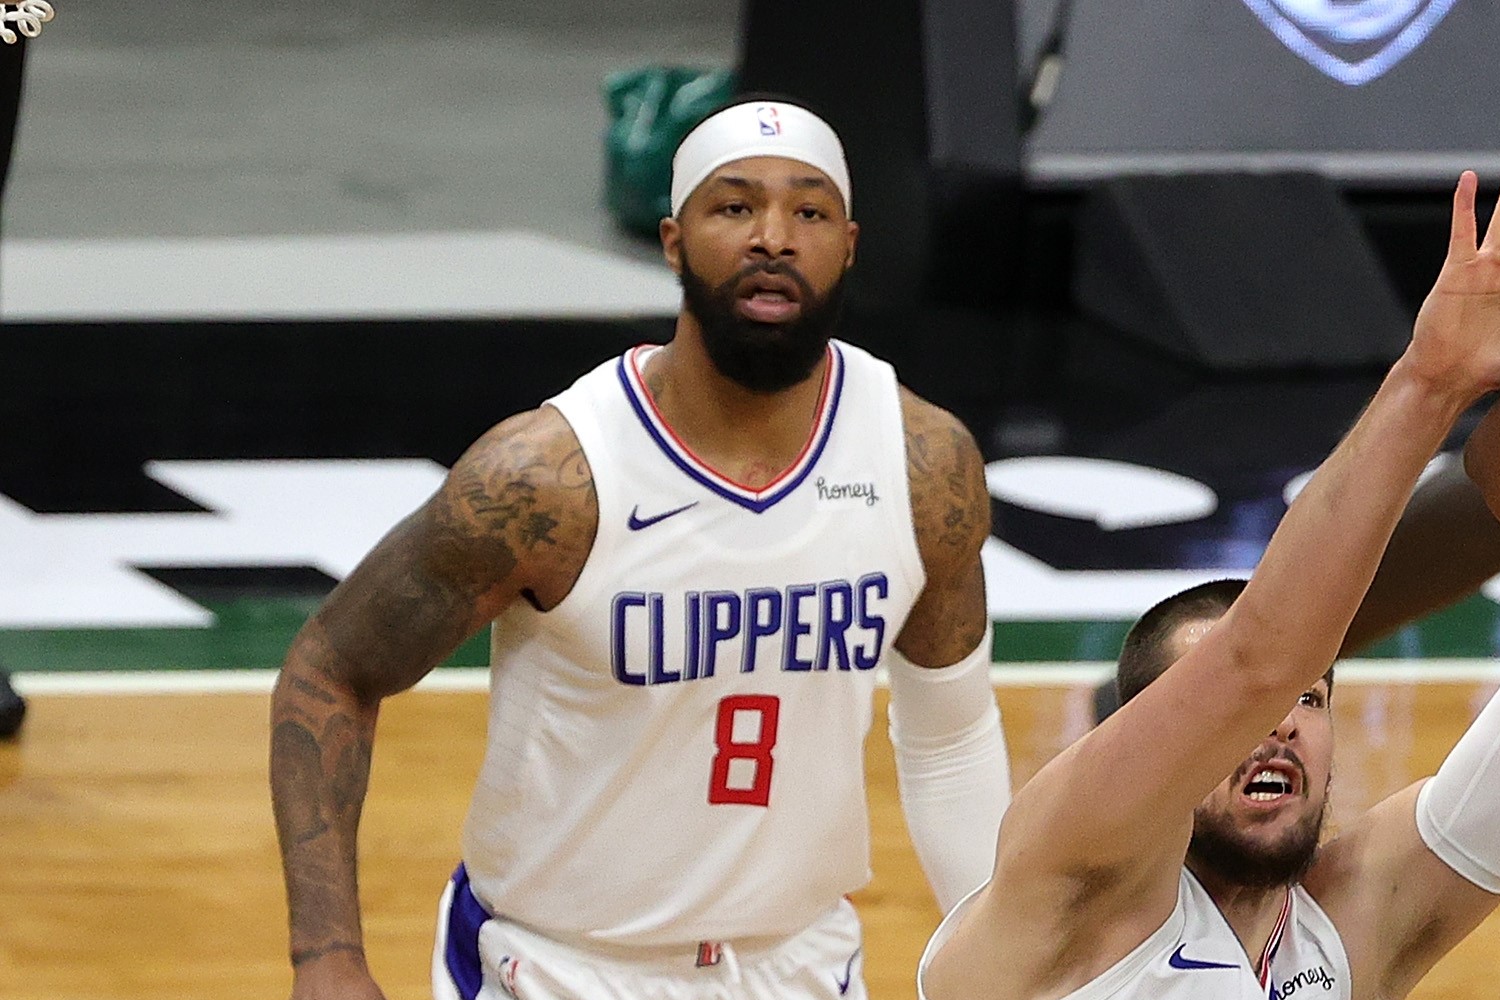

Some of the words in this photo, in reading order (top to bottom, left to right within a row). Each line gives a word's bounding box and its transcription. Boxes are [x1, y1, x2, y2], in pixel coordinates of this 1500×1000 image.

[814, 476, 880, 507] honey
[610, 571, 888, 686] CLIPPERS
[708, 694, 779, 806] 8
